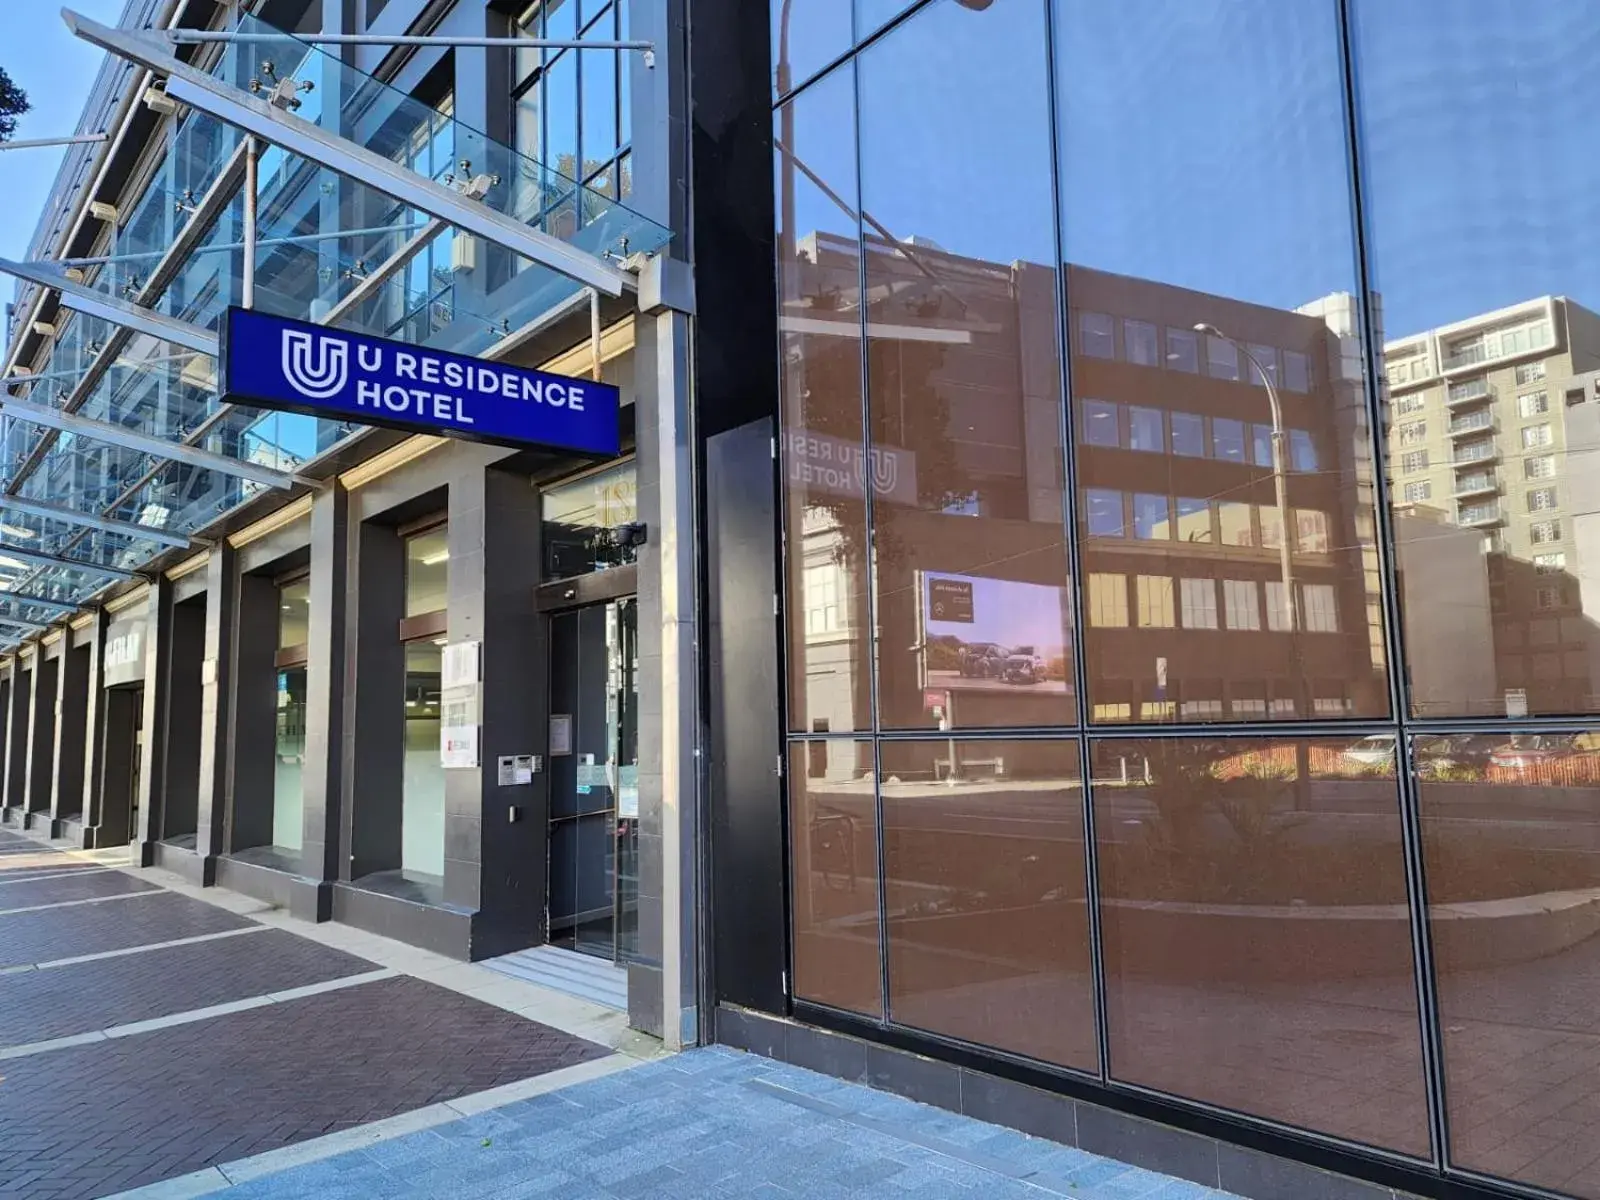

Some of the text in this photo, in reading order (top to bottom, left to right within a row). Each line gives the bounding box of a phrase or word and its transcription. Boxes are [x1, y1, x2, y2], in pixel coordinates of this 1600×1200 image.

[357, 379, 474, 424] HOTEL
[358, 344, 585, 411] U RESIDENCE
